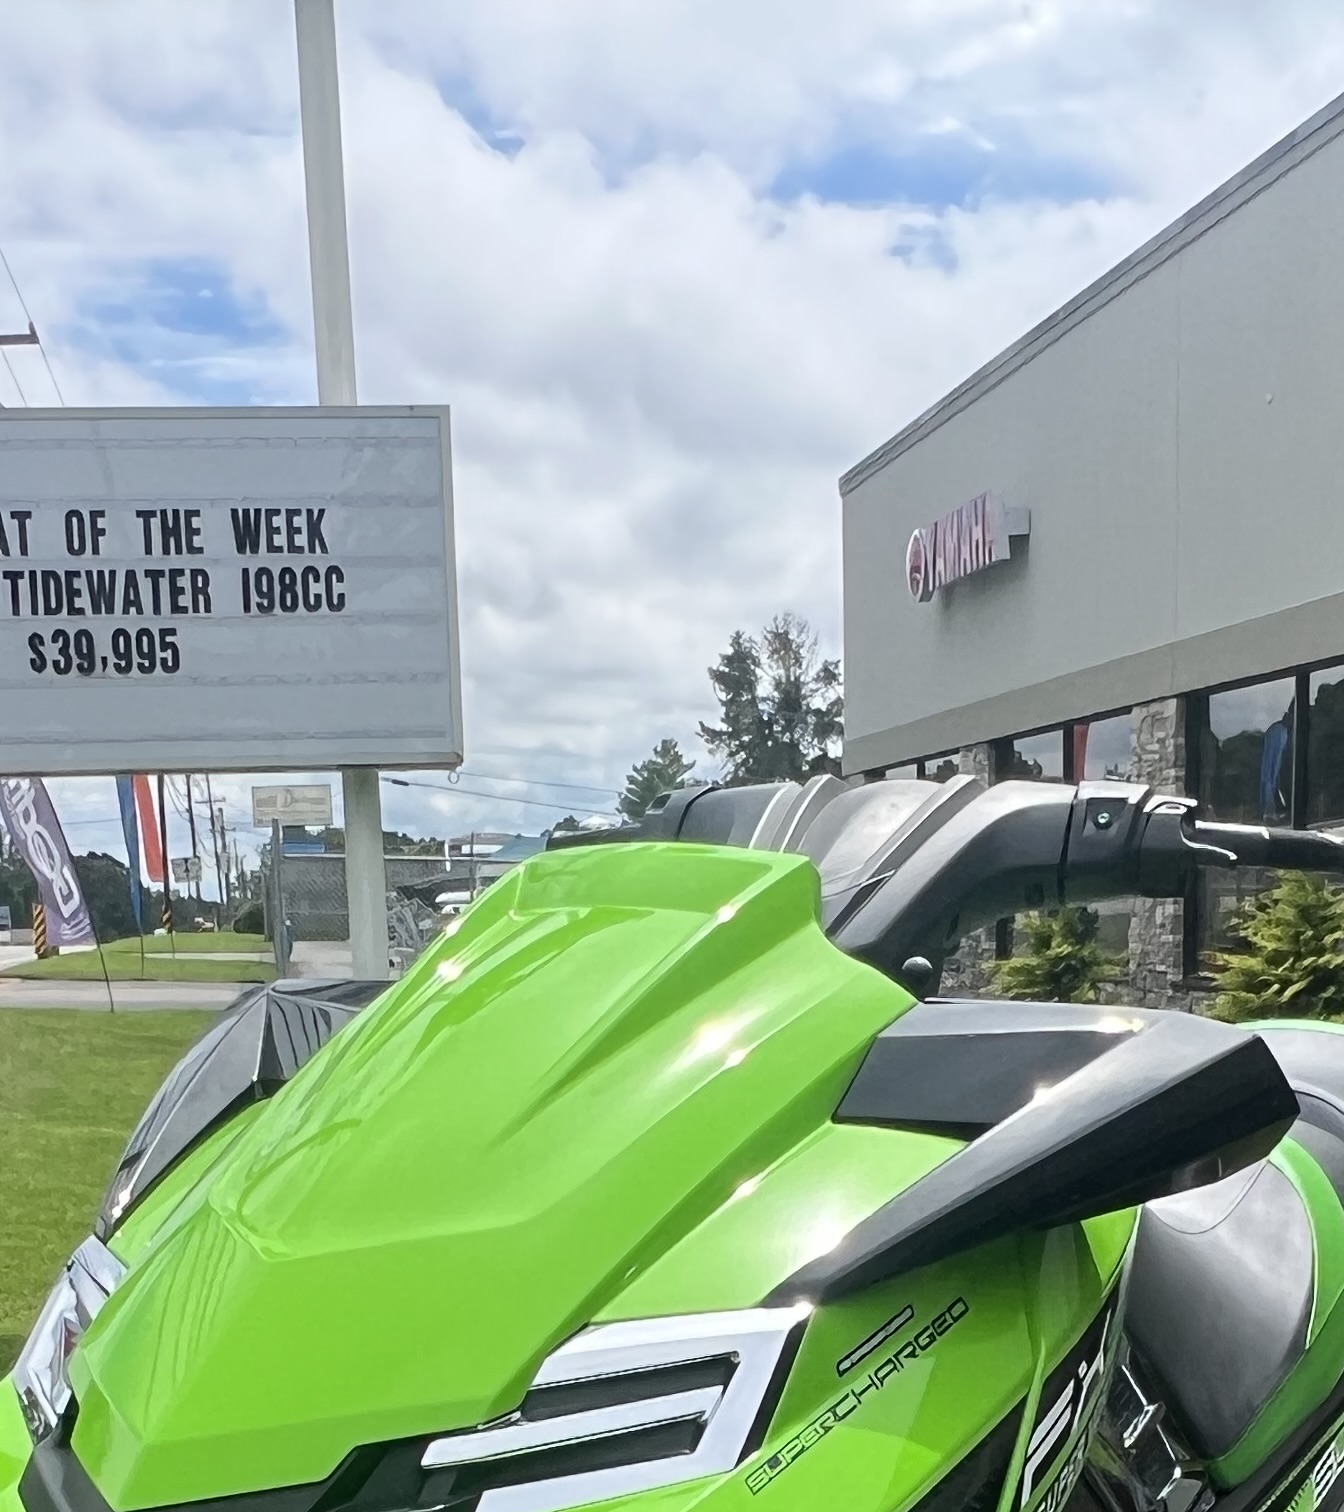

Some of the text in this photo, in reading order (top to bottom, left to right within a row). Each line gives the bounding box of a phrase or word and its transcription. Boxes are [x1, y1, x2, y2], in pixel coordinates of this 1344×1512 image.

[64, 509, 107, 557] OF
[135, 509, 205, 557] THE
[230, 507, 329, 555] WEEK
[2, 567, 213, 617] TIDEWATER
[27, 627, 181, 676] $39,995
[745, 1297, 969, 1495] SUPERCHARGED
